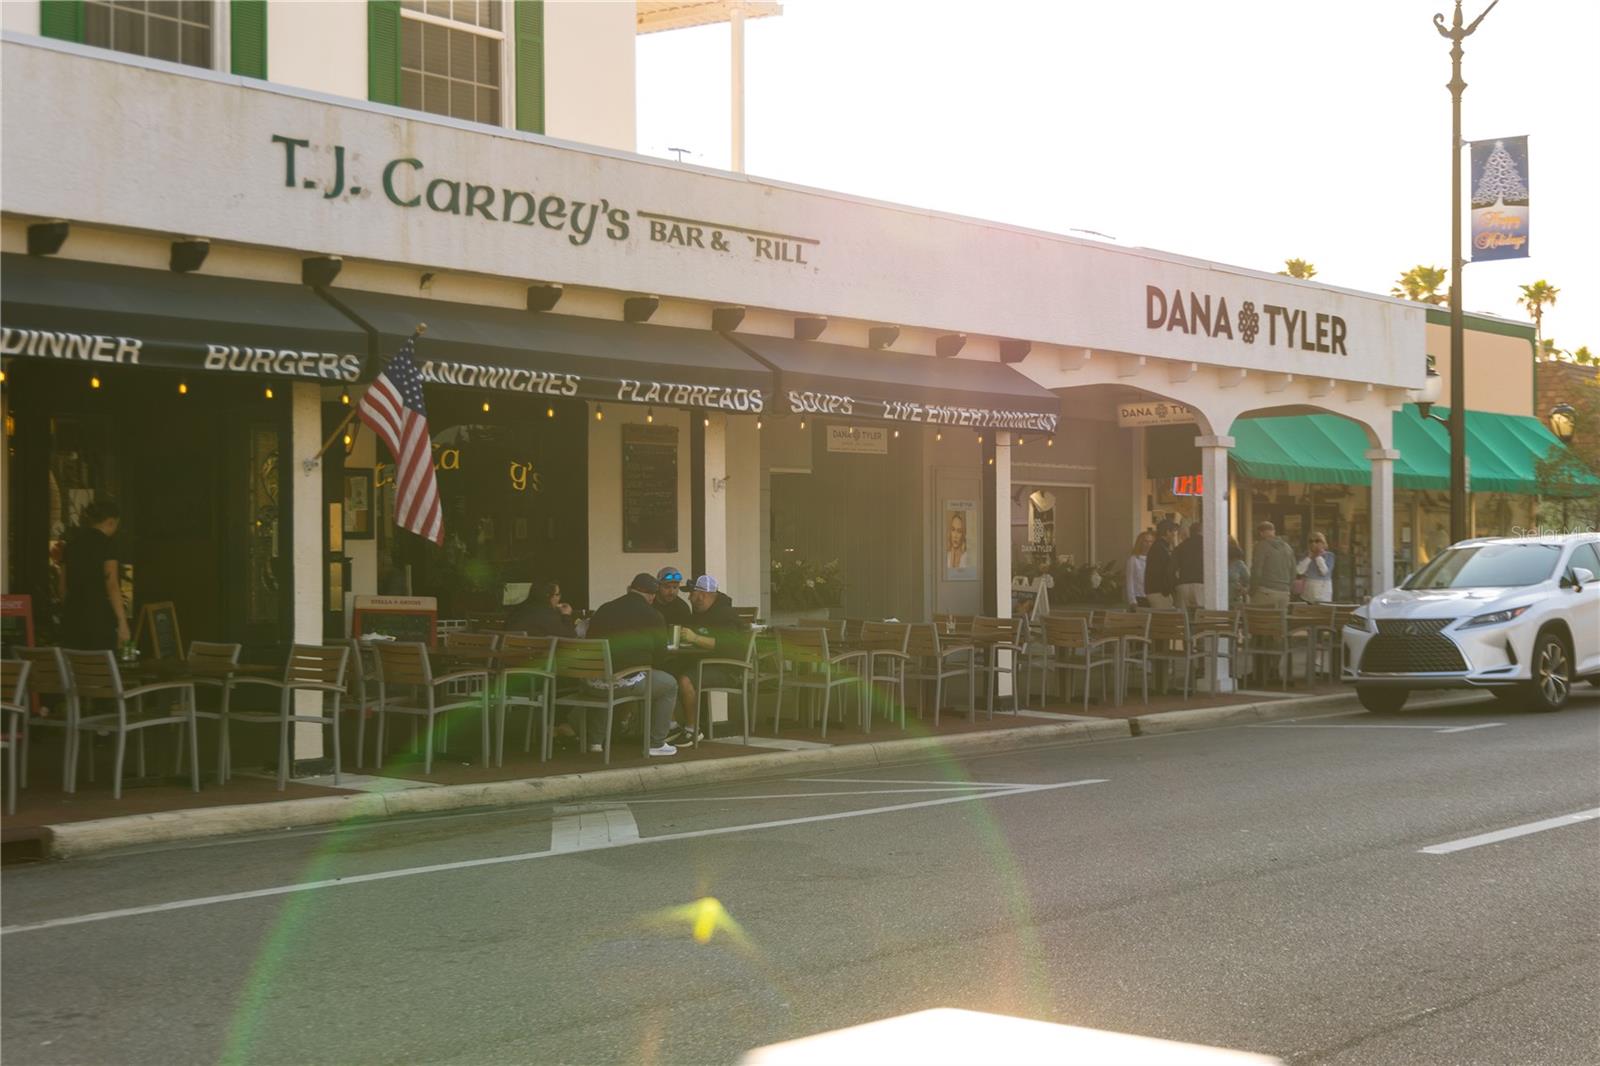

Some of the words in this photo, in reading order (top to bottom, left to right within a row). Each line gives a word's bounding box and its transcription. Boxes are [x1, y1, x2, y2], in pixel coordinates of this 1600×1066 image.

[272, 134, 362, 199] T.J.
[382, 157, 630, 246] Carney's
[650, 220, 705, 248] BAR
[710, 230, 731, 252] &
[747, 235, 808, 265] RILL
[1146, 285, 1234, 340] DANA
[1263, 304, 1348, 356] TYLER
[1, 327, 143, 364] DINNER
[204, 343, 362, 382] BURGERS
[417, 360, 581, 396] ANDWICHES
[616, 379, 764, 413] FLATBREADS
[787, 390, 856, 415] SOUPS
[882, 400, 923, 422] LIVE
[925, 404, 1058, 432] ENTERTAINMENT
[1121, 408, 1153, 418] DANA
[862, 431, 882, 440] TYLER
